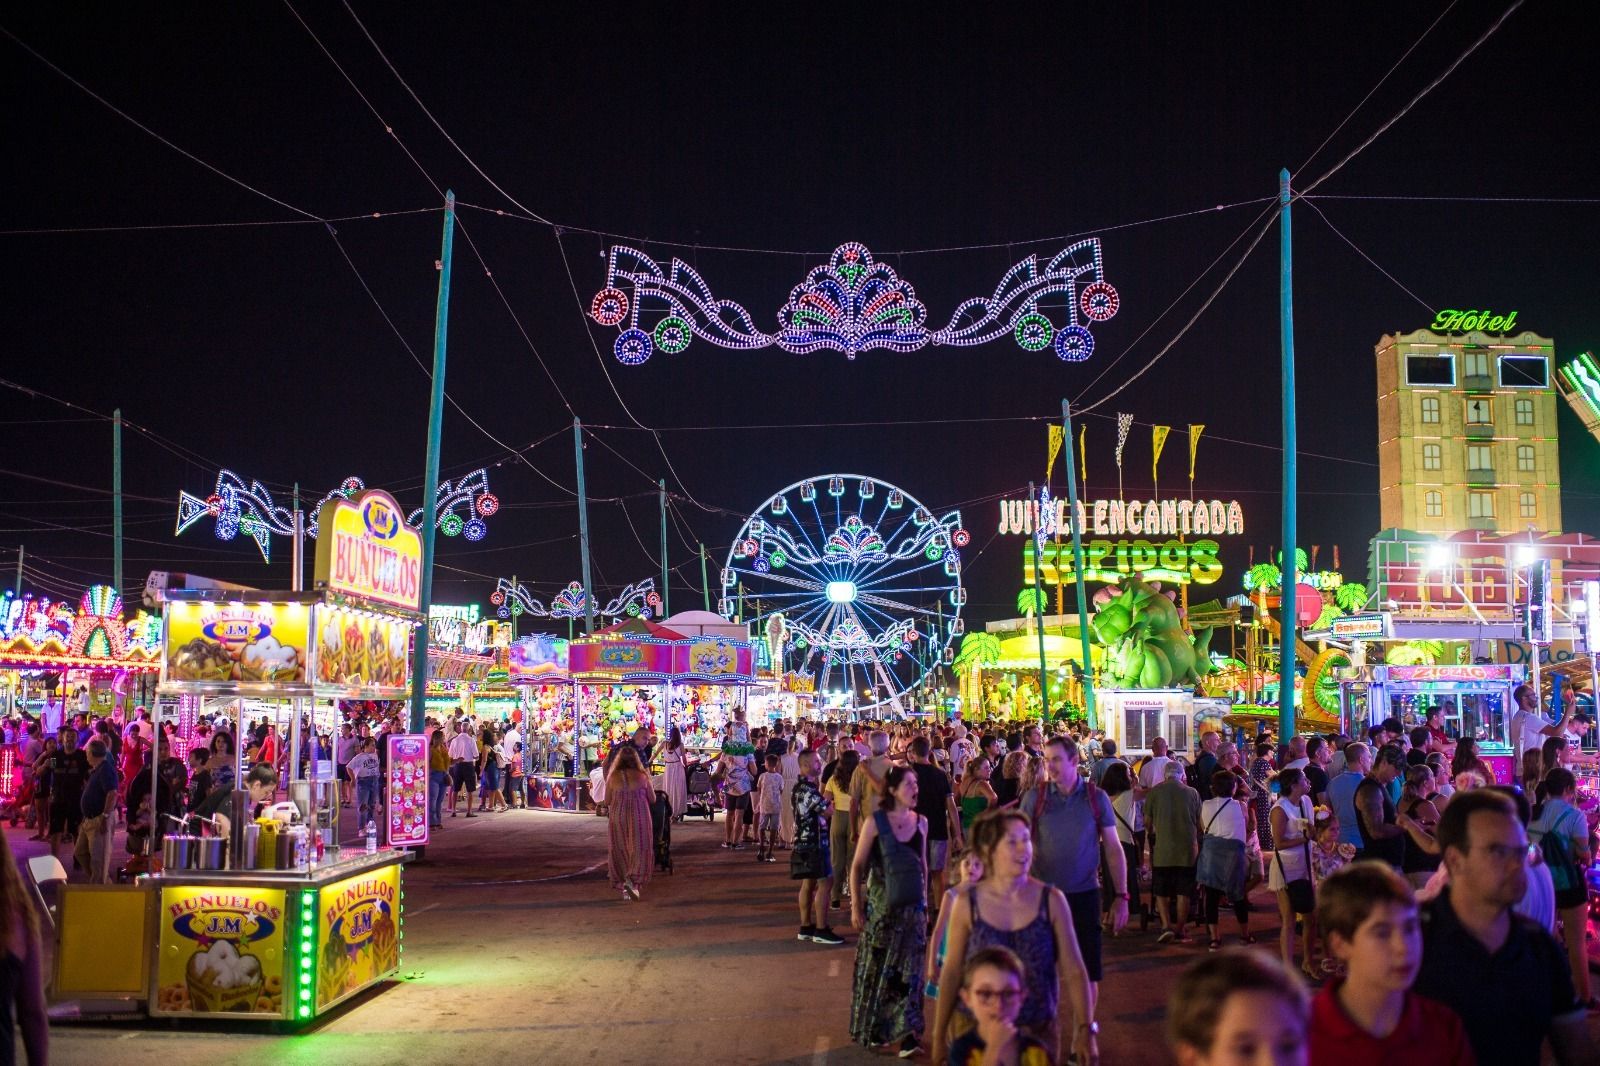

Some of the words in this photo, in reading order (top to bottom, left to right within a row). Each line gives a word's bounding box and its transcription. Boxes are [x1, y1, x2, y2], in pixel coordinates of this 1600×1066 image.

[1431, 309, 1518, 331] Hotel
[1094, 499, 1244, 536] ENCANTADA
[206, 916, 242, 934] J.M
